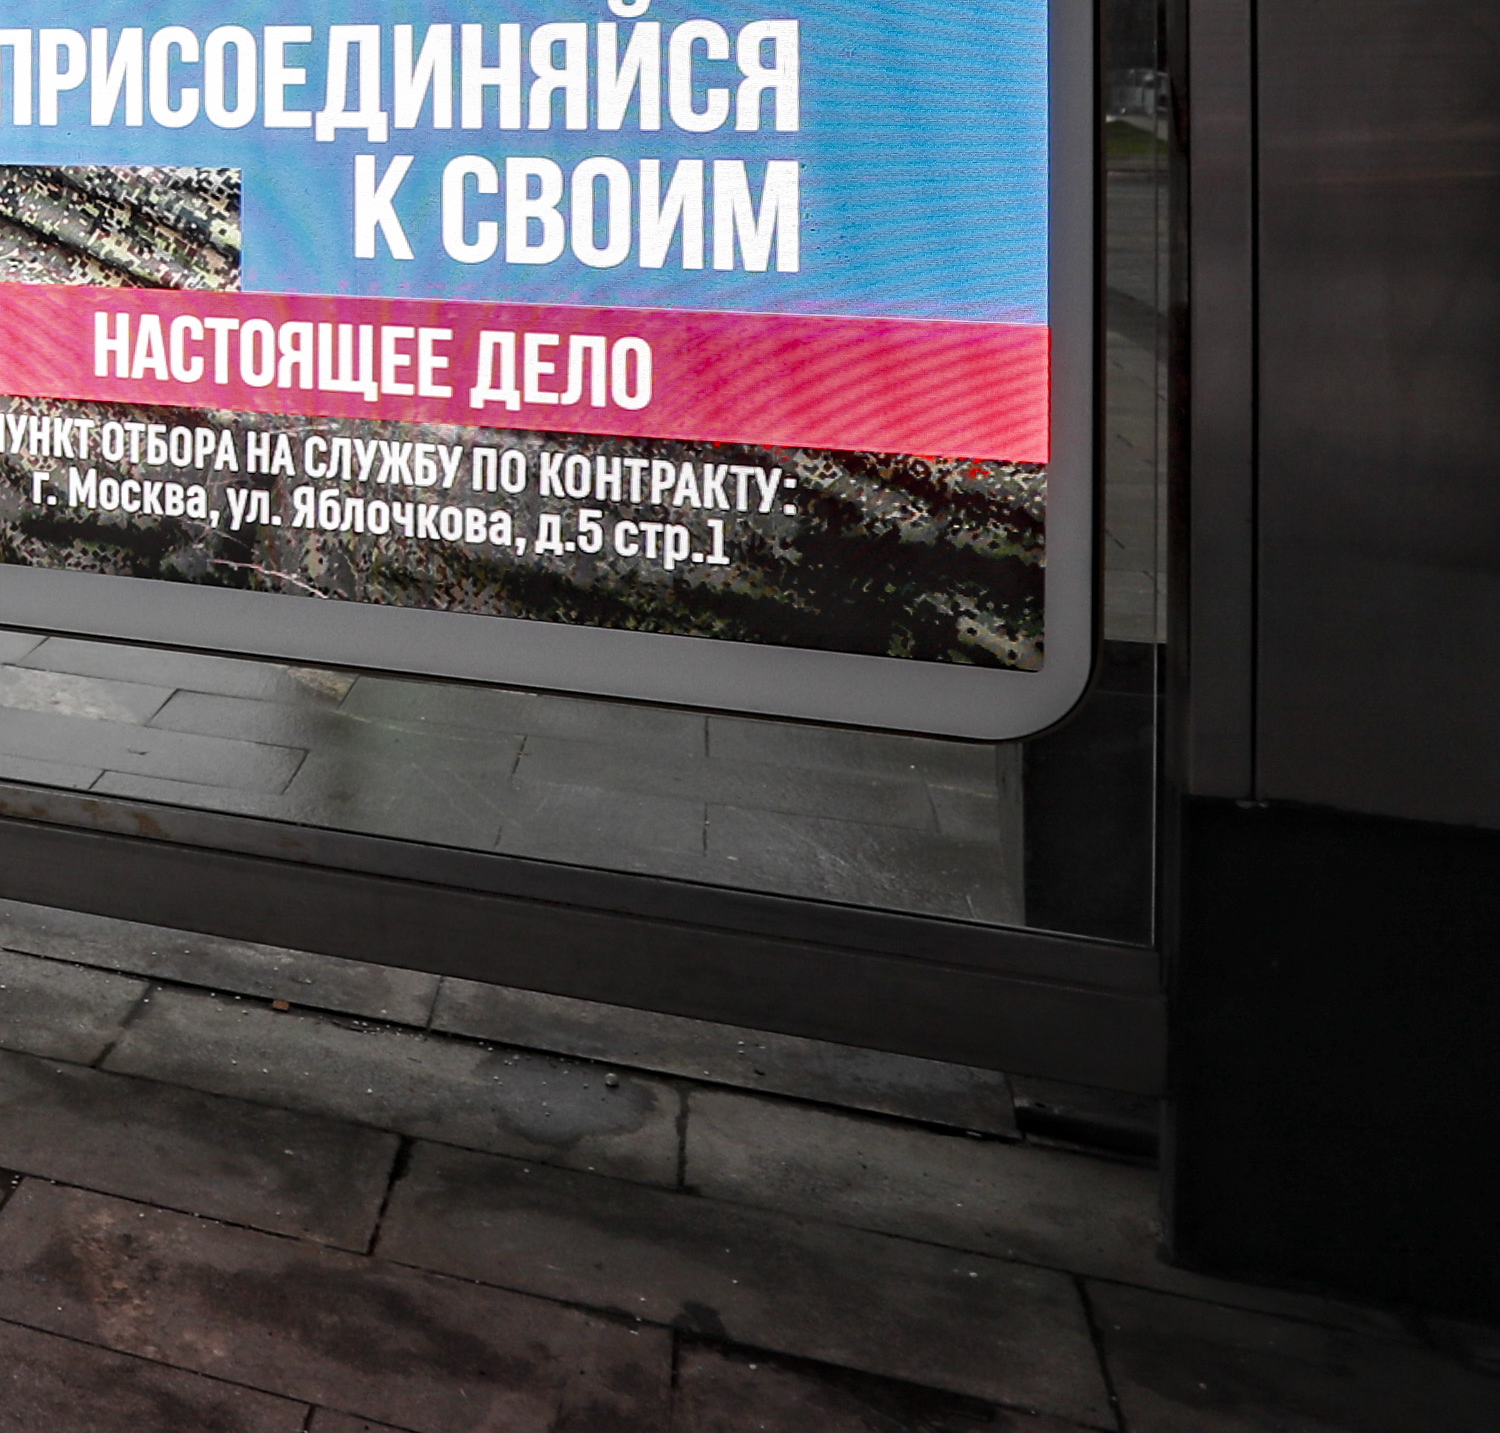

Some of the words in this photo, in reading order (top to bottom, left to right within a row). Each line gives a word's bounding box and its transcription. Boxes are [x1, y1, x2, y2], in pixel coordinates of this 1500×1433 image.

[353, 154, 414, 260] К
[441, 154, 800, 274] СВОИМ
[93, 311, 453, 403] НАСТОЯЩЕЕ
[469, 329, 653, 412] ДЕЛО
[31, 471, 58, 507] г.
[68, 467, 220, 529] Москва,
[225, 486, 283, 532] ул.
[291, 486, 527, 557] Яблочкова,
[534, 508, 604, 557] д.5
[613, 518, 731, 571] стр.1
[100, 420, 239, 473] ОТБОРА
[246, 431, 296, 477] НА
[304, 434, 463, 490] СЛУЖБУ
[471, 445, 527, 494] ПО
[539, 451, 798, 516] КОНТРАКТУ:
